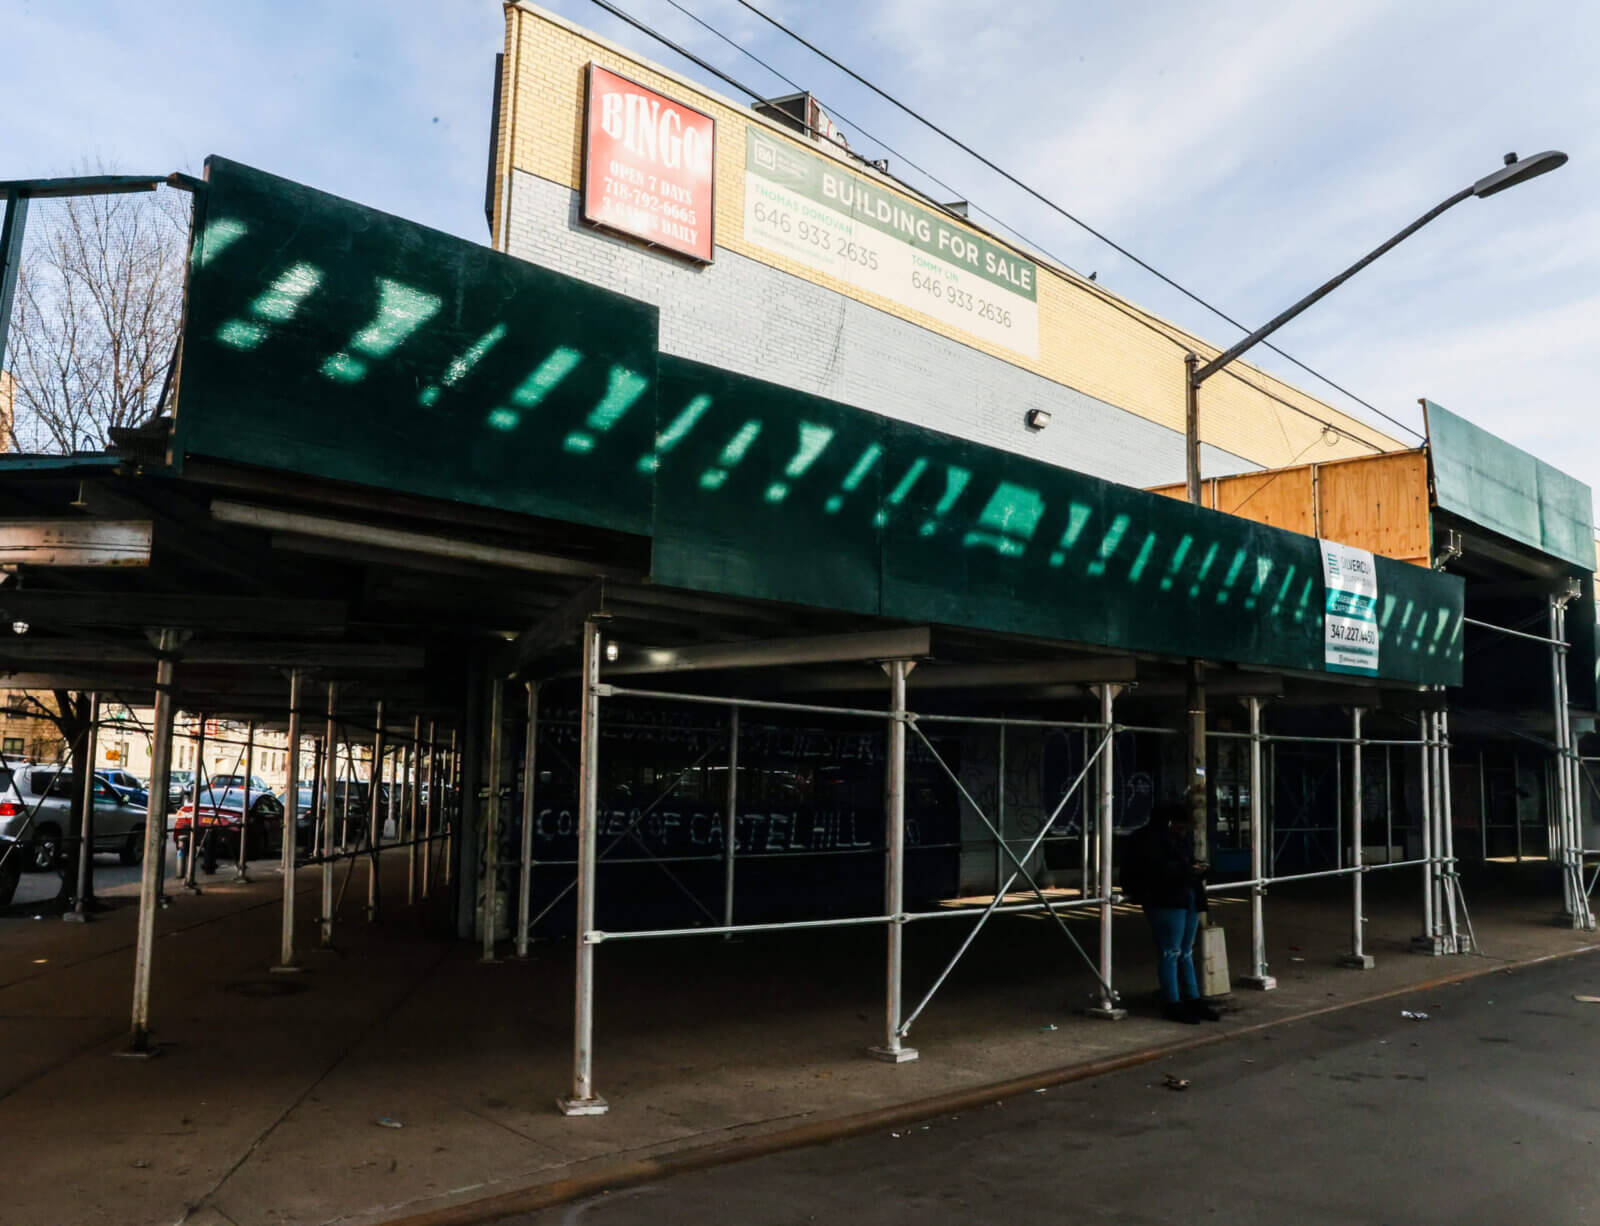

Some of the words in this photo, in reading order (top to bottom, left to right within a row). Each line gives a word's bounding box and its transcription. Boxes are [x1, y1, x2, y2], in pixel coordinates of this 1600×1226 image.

[610, 160, 645, 186] OPEN
[648, 176, 657, 191] 7
[661, 181, 692, 206] DAYS
[753, 183, 800, 212] THOMAS
[801, 206, 853, 236] DONOVAN
[662, 219, 698, 245] DAILY
[753, 201, 792, 233] 646
[797, 220, 831, 251] 933
[837, 238, 879, 271] 2635
[822, 172, 931, 243] BUILDING
[938, 228, 979, 266] FOR
[985, 252, 1032, 291] SALE
[911, 270, 942, 299] 646
[946, 286, 974, 312] 933
[977, 299, 1013, 329] 2636
[535, 807, 645, 841] CONER
